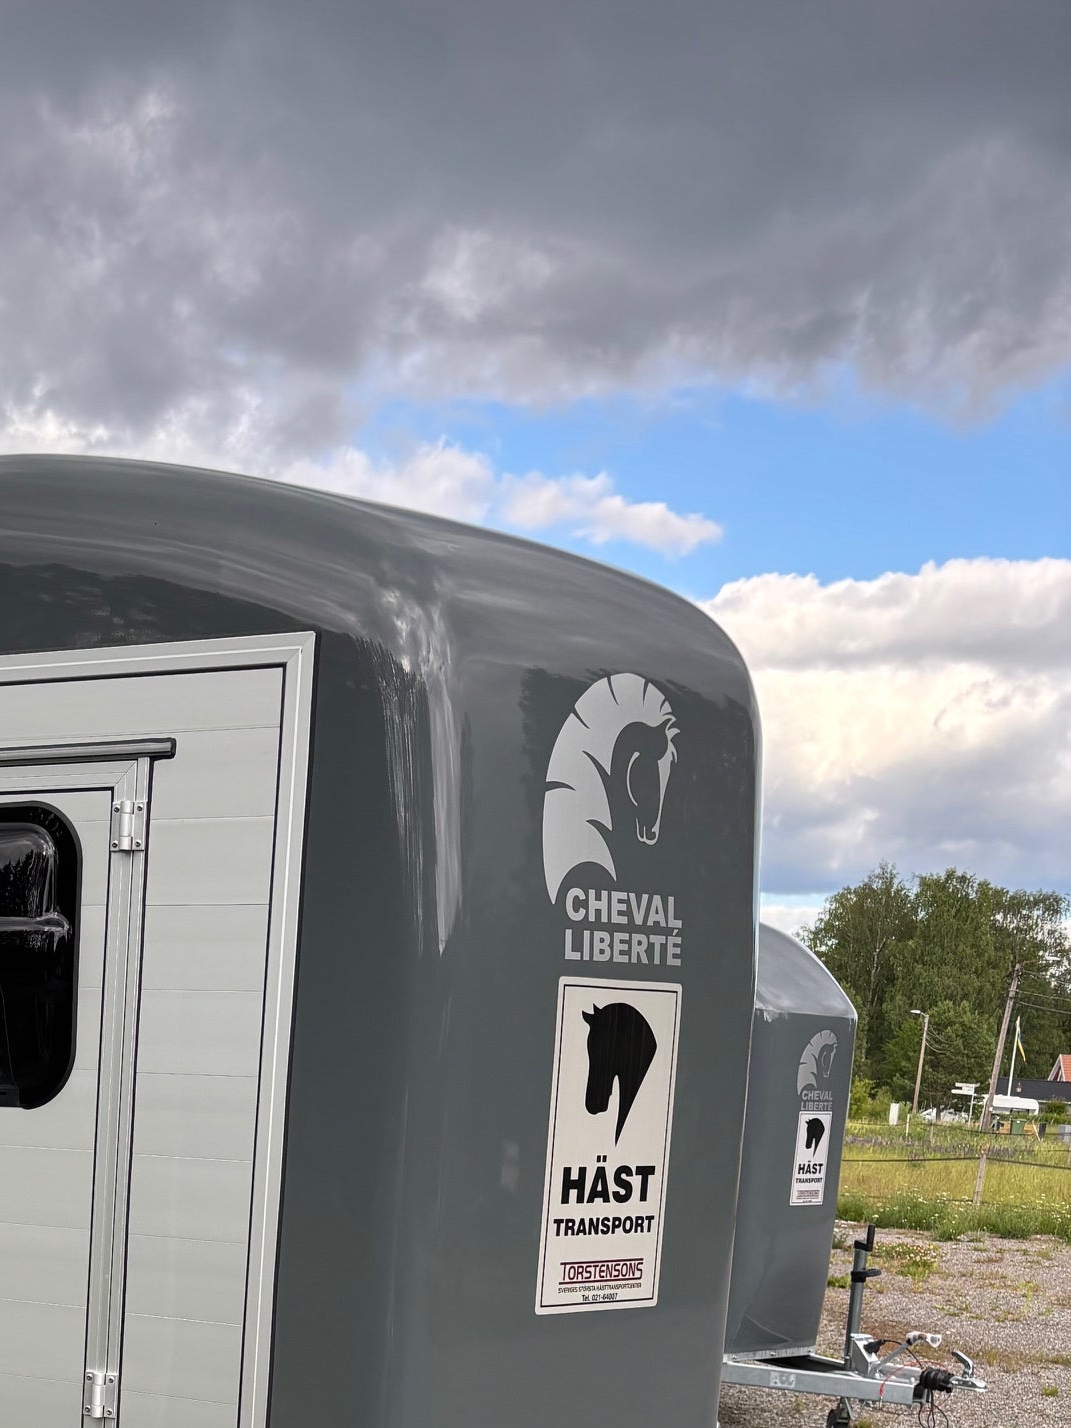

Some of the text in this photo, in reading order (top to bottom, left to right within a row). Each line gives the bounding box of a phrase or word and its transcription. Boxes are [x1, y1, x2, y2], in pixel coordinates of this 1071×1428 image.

[565, 887, 683, 929] CHEVAL
[564, 928, 682, 966] LIBERTÉ
[801, 1090, 833, 1101] CHEVAL
[561, 1155, 656, 1204] HÄST
[797, 1160, 824, 1175] HÄST
[553, 1215, 655, 1237] TRANSPORT
[559, 1258, 644, 1285] TORSTENSONS
